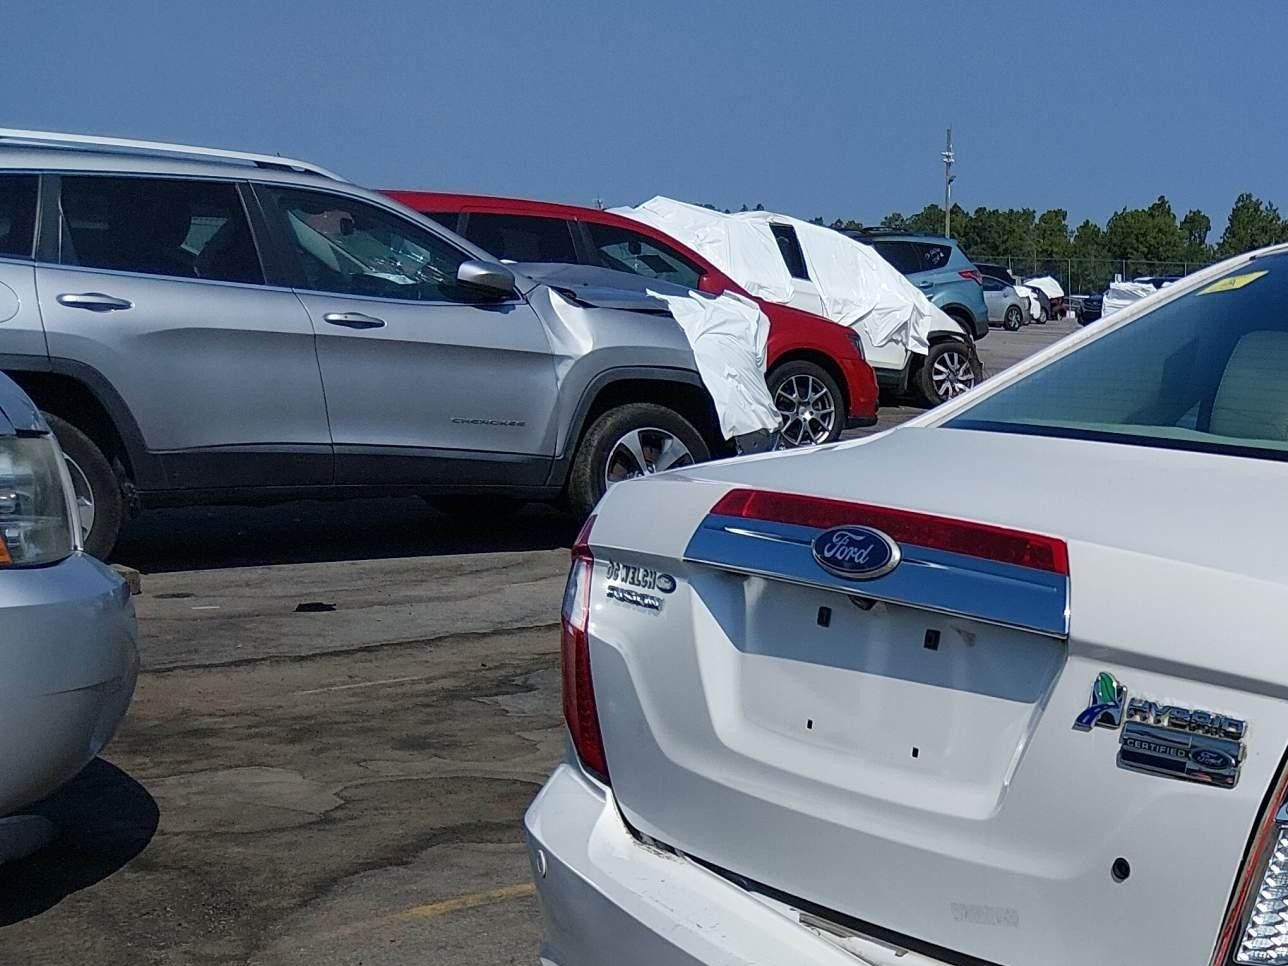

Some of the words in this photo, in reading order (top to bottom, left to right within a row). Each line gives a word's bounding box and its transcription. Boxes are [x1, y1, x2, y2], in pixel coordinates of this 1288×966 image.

[450, 417, 526, 427] CHEROKEE
[823, 530, 874, 564] Ford
[620, 564, 657, 590] WELCH
[1126, 739, 1187, 758] CERTIFIED
